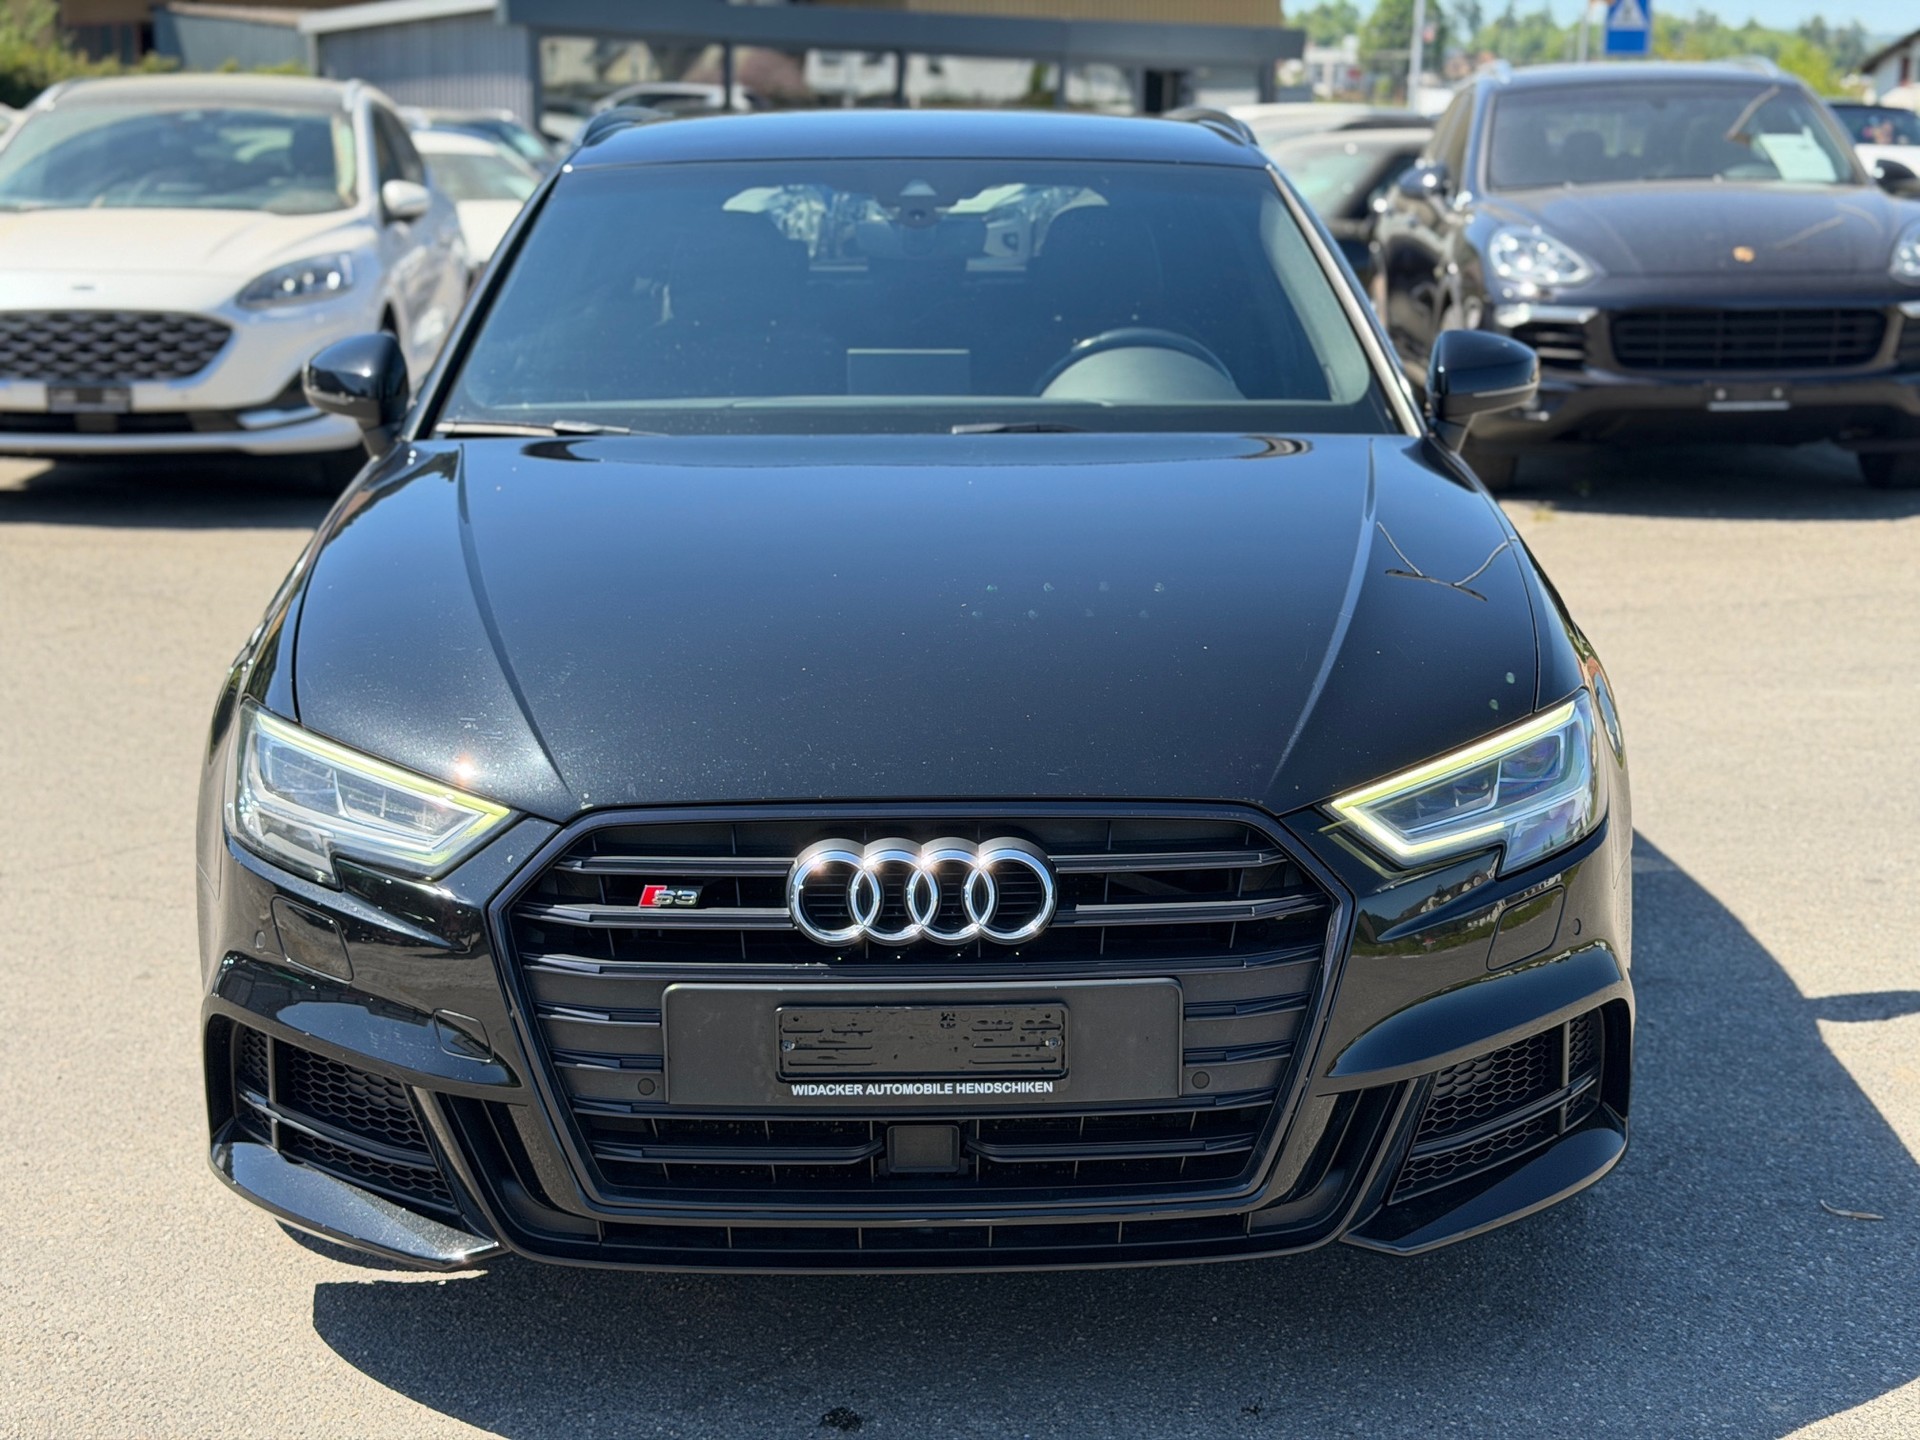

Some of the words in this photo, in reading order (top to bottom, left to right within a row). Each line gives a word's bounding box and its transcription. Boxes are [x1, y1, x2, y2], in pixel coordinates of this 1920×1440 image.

[650, 888, 699, 906] S3
[791, 1084, 864, 1096] WIDACKER
[865, 1083, 954, 1095] AUTOMOBILE
[955, 1082, 1054, 1095] HENDSCHIKEN
